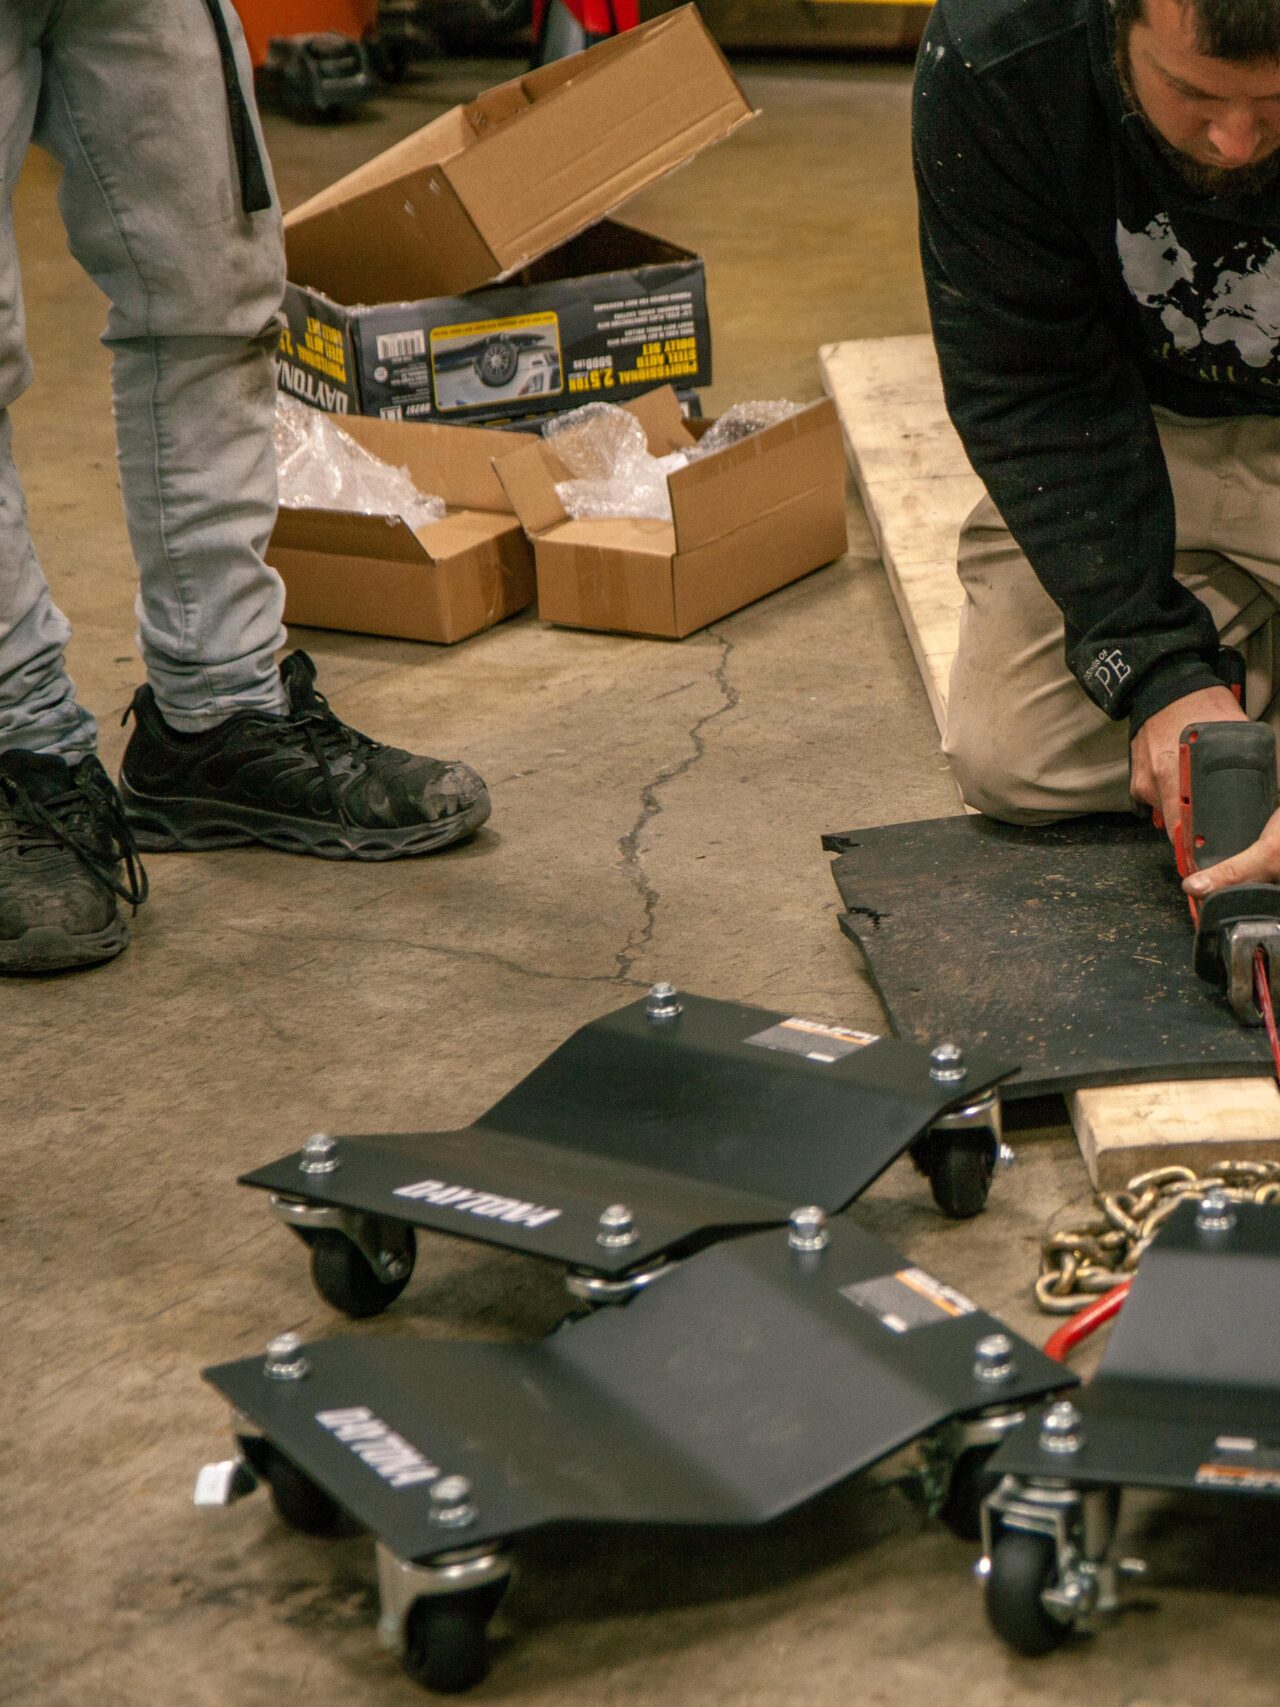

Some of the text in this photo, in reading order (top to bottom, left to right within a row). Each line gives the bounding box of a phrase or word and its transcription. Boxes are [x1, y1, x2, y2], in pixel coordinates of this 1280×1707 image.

[618, 361, 698, 385] PROFESSIONAL
[392, 1179, 563, 1228] DAYTONA
[315, 1406, 440, 1488] DAYTONA
